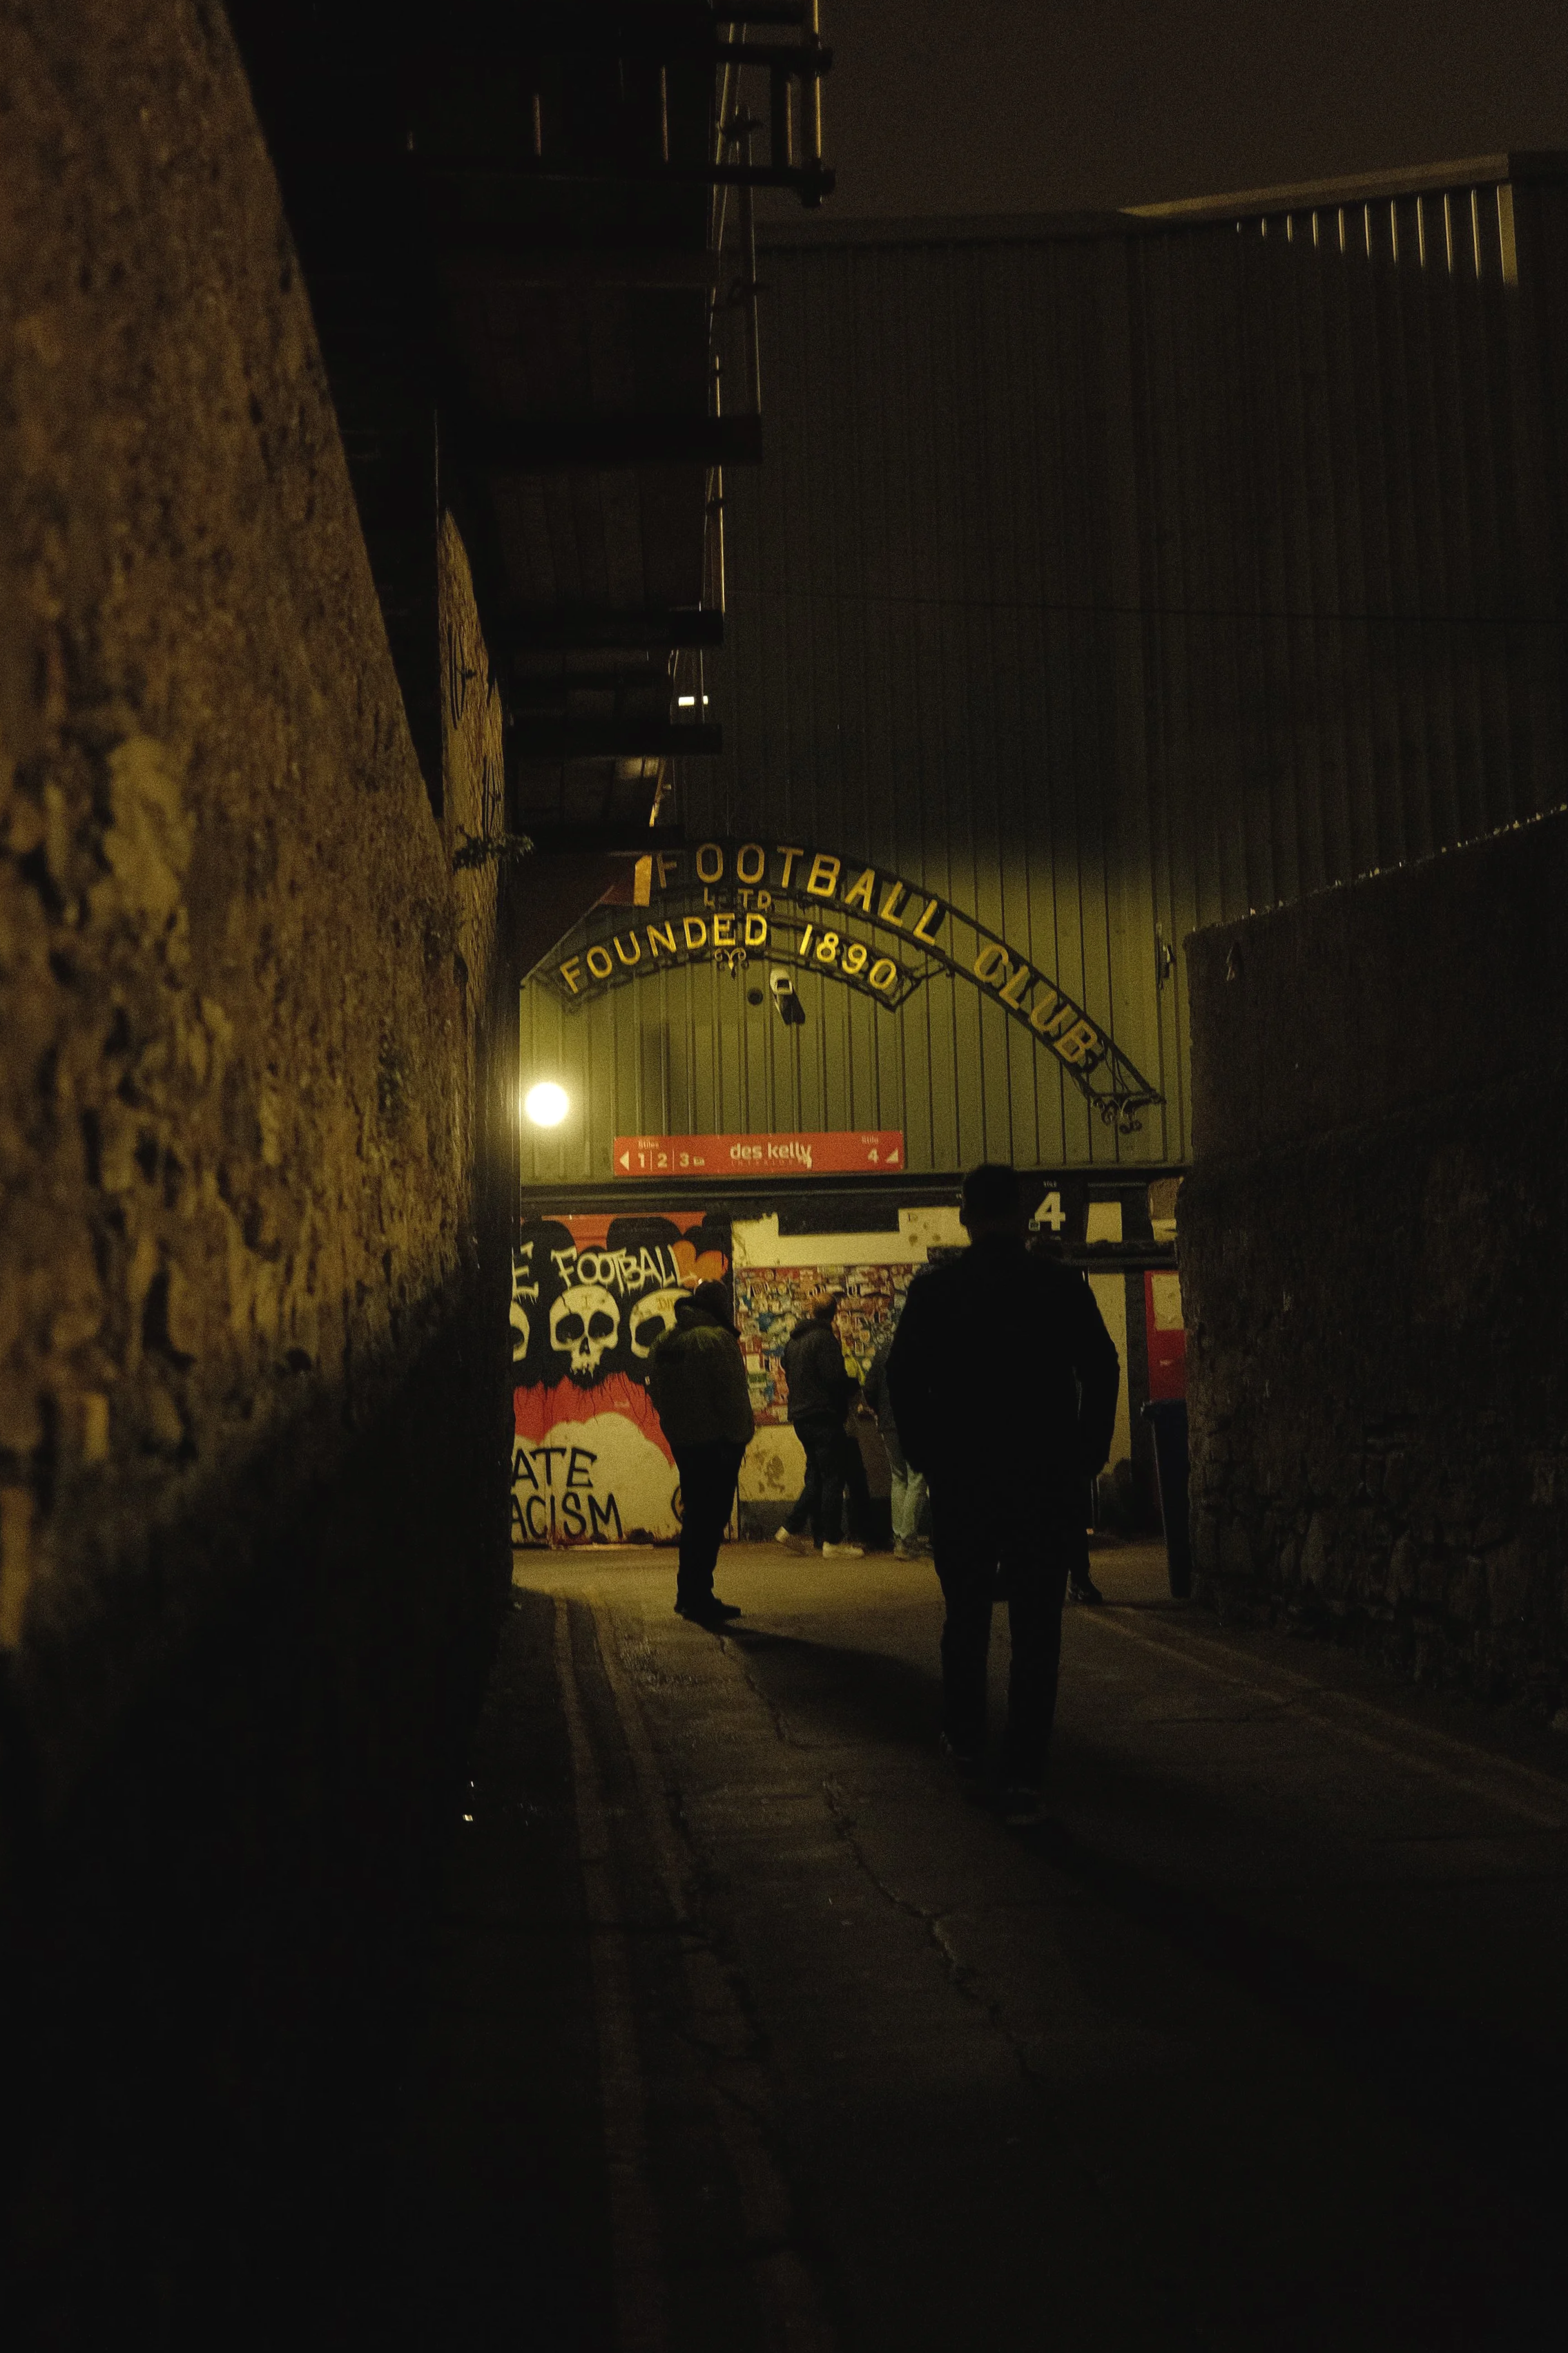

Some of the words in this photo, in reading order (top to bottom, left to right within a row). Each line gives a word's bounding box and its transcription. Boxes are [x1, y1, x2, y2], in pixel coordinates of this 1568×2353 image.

[559, 912, 768, 995] FOUNDED
[799, 923, 898, 990] 1890
[656, 842, 940, 947] FOOTBALL
[974, 943, 1098, 1064] CLUB
[637, 1152, 645, 1169] 1
[657, 1152, 668, 1168] 2
[679, 1151, 690, 1168] 3
[730, 1142, 763, 1160] des
[767, 1141, 813, 1169] kelly
[867, 1146, 880, 1164] 4
[1034, 1191, 1066, 1231] 4
[550, 1243, 698, 1296] FOOTBALL
[511, 1447, 598, 1489] ATE
[511, 1492, 623, 1540] ACISM
